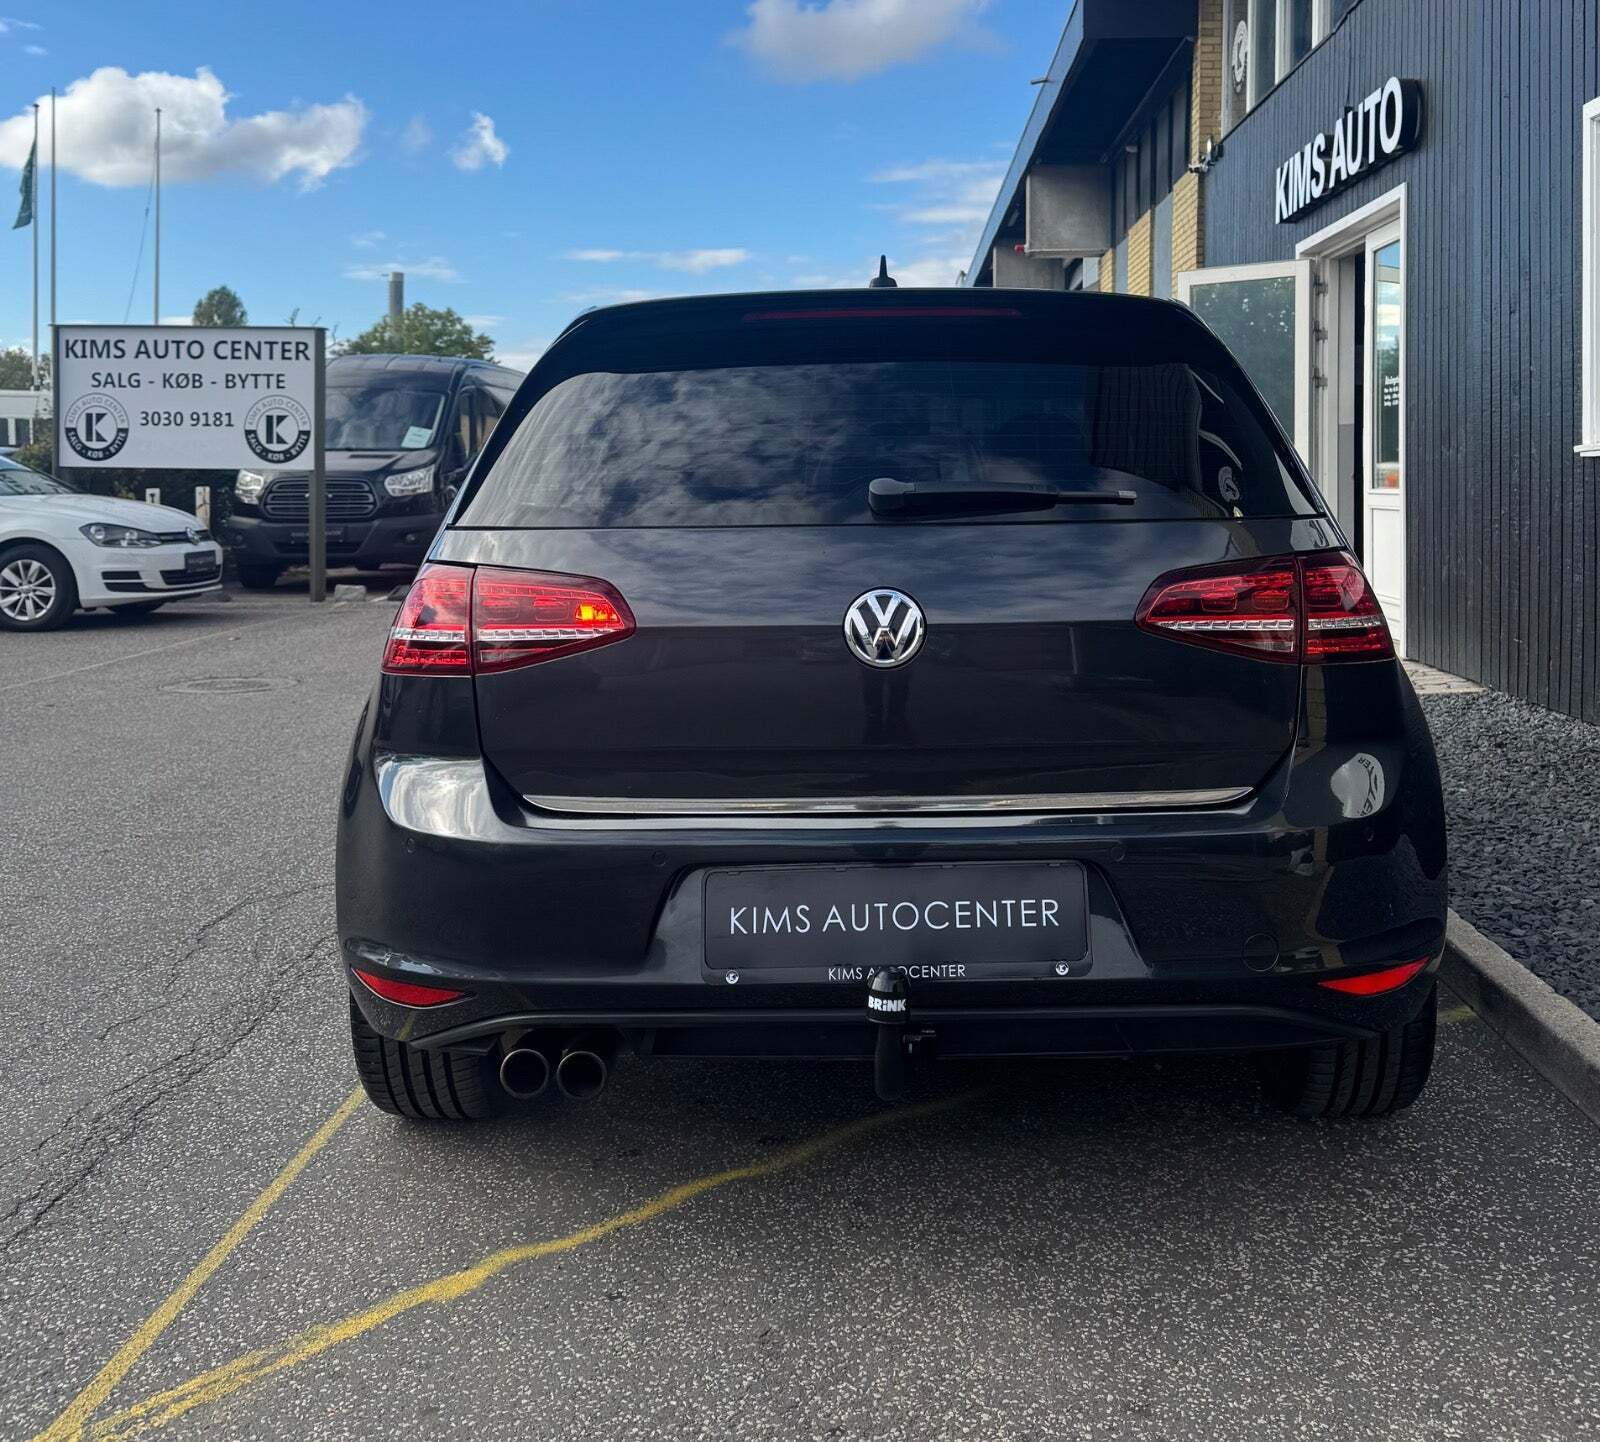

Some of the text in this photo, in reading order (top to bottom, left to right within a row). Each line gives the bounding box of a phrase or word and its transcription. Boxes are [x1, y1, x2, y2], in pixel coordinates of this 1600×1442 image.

[1275, 76, 1403, 224] KIMS AUTO
[65, 339, 311, 361] KIMS AUTO CENTER
[91, 372, 141, 389] SALG
[162, 372, 203, 389] KØB
[225, 373, 286, 389] BYTTE
[85, 412, 108, 442] K
[140, 411, 234, 427] 3030 9181
[265, 414, 289, 445] K
[730, 899, 1060, 935] KIMS AUTOCENTER
[828, 967, 862, 980] KIMS
